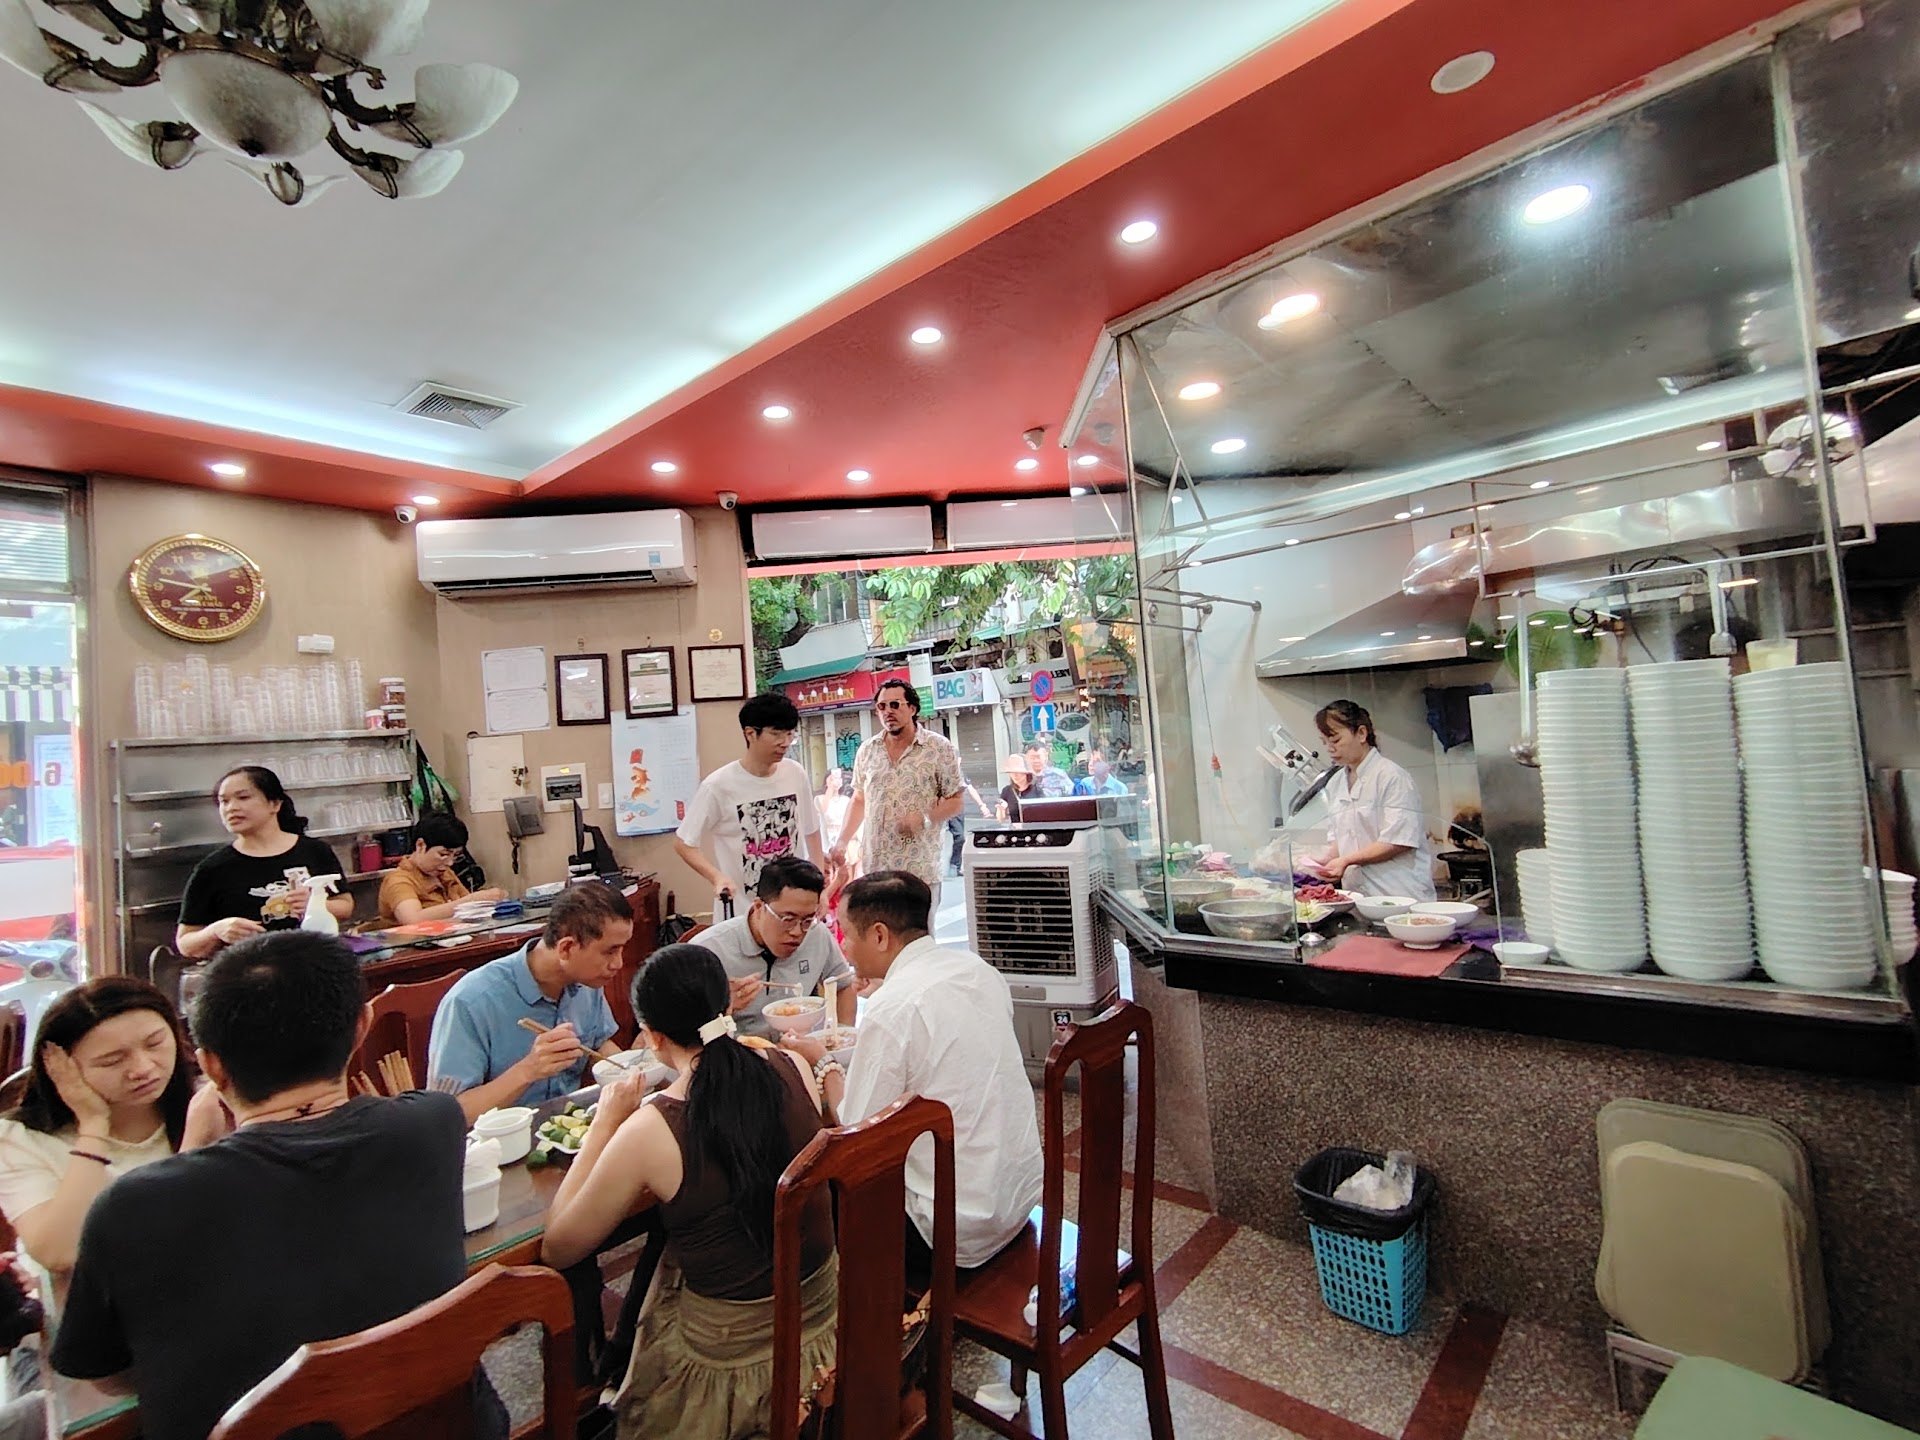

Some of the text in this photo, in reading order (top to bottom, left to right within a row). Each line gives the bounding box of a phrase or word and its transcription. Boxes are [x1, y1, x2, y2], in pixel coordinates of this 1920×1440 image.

[172, 555, 184, 564] 11
[191, 551, 206, 560] 12
[159, 566, 175, 576] 10
[228, 568, 240, 579] 2
[153, 581, 164, 592] 9
[235, 585, 247, 595] 3
[161, 599, 172, 609] 8
[231, 601, 241, 610] 4
[177, 611, 188, 620] 7
[219, 612, 229, 622] 5
[198, 616, 209, 626] 6
[936, 677, 966, 700] BAG
[1056, 1015, 1069, 1025] 24
